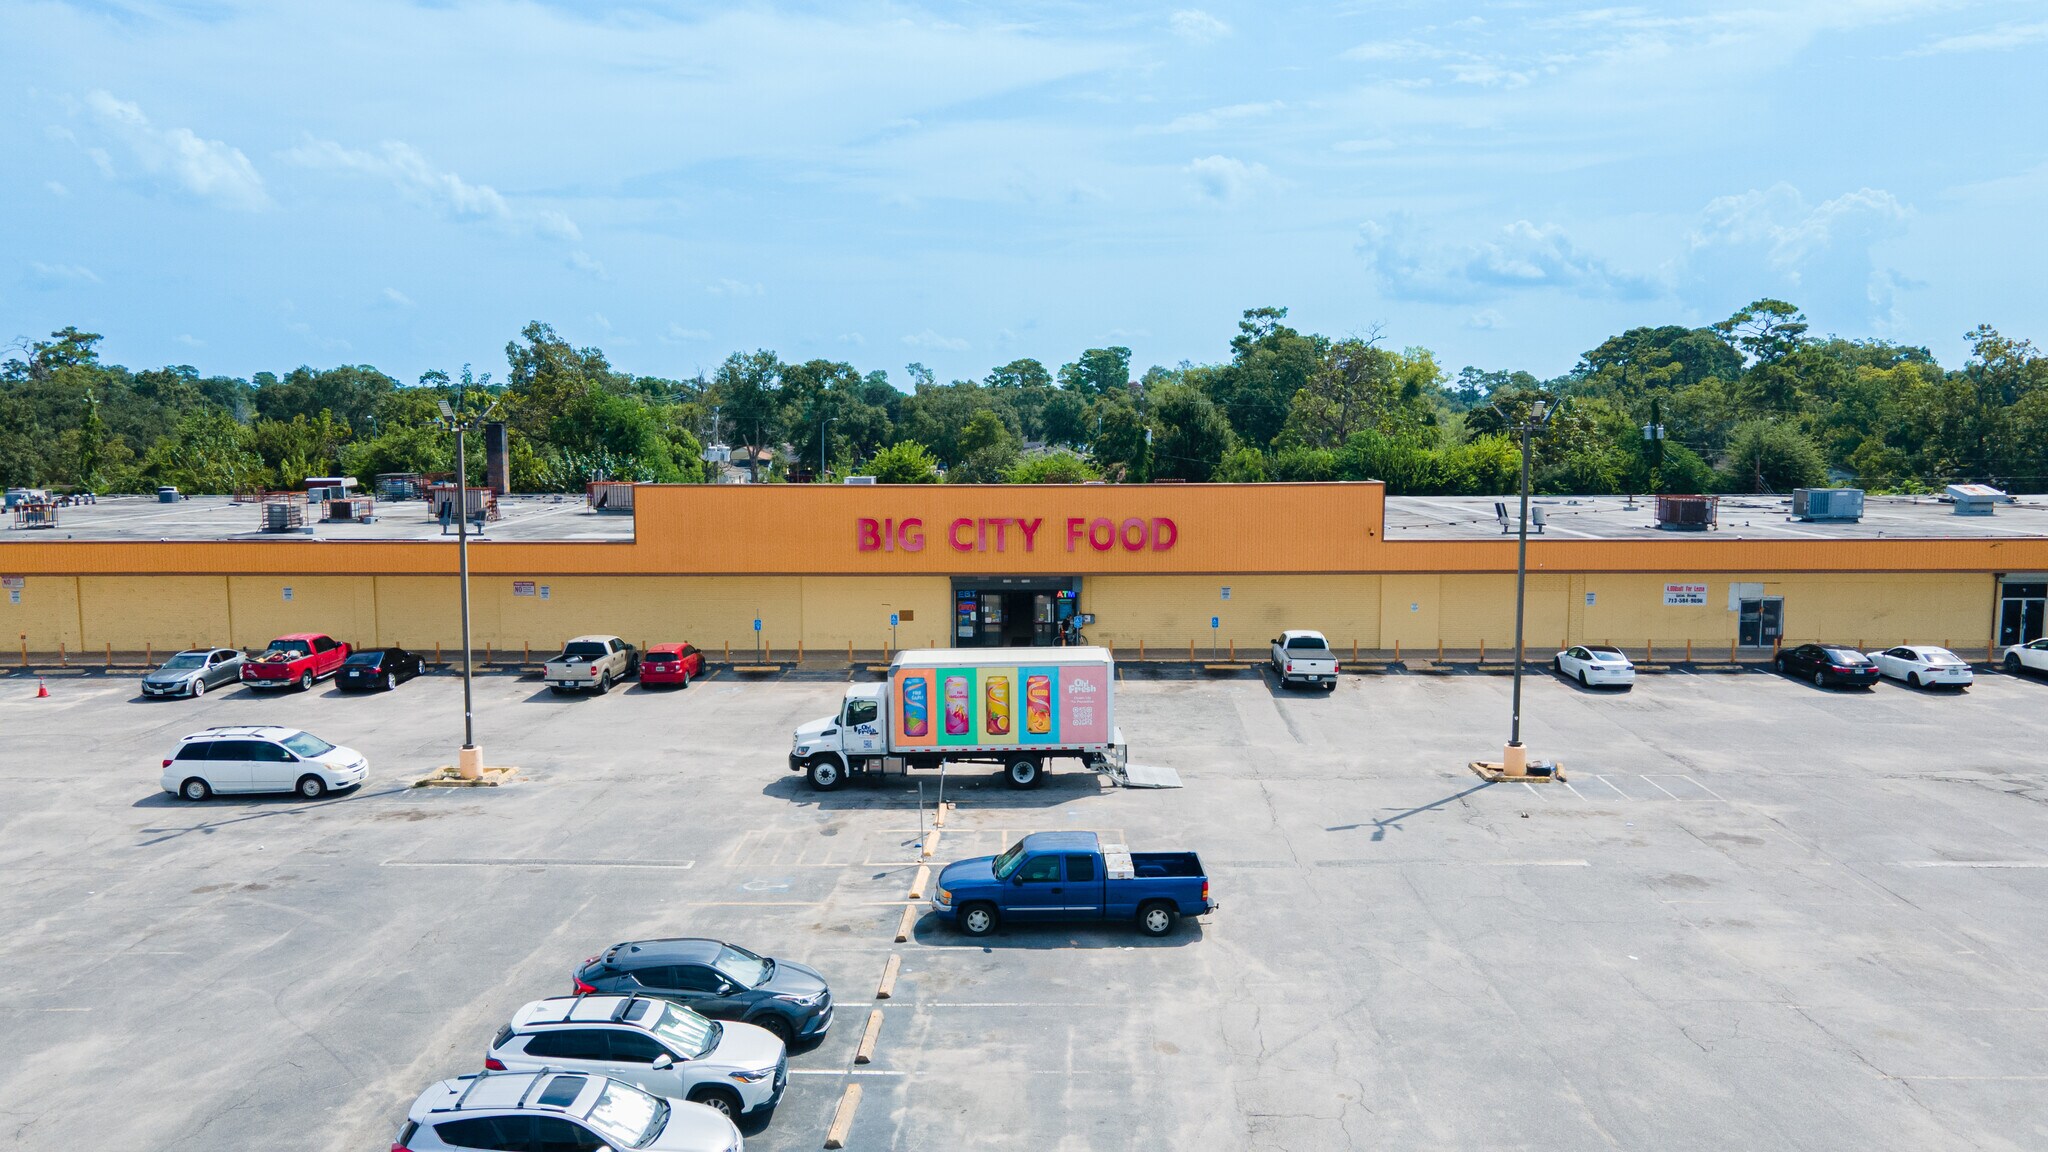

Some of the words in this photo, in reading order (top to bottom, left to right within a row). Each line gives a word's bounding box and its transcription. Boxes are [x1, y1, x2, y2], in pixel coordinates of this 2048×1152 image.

[857, 517, 925, 552] BIG
[949, 517, 1043, 552] CITY
[1066, 517, 1178, 552] FOOD
[958, 590, 976, 598] EBT
[1074, 678, 1089, 688] Oh!
[1068, 684, 1097, 694] Fresh
